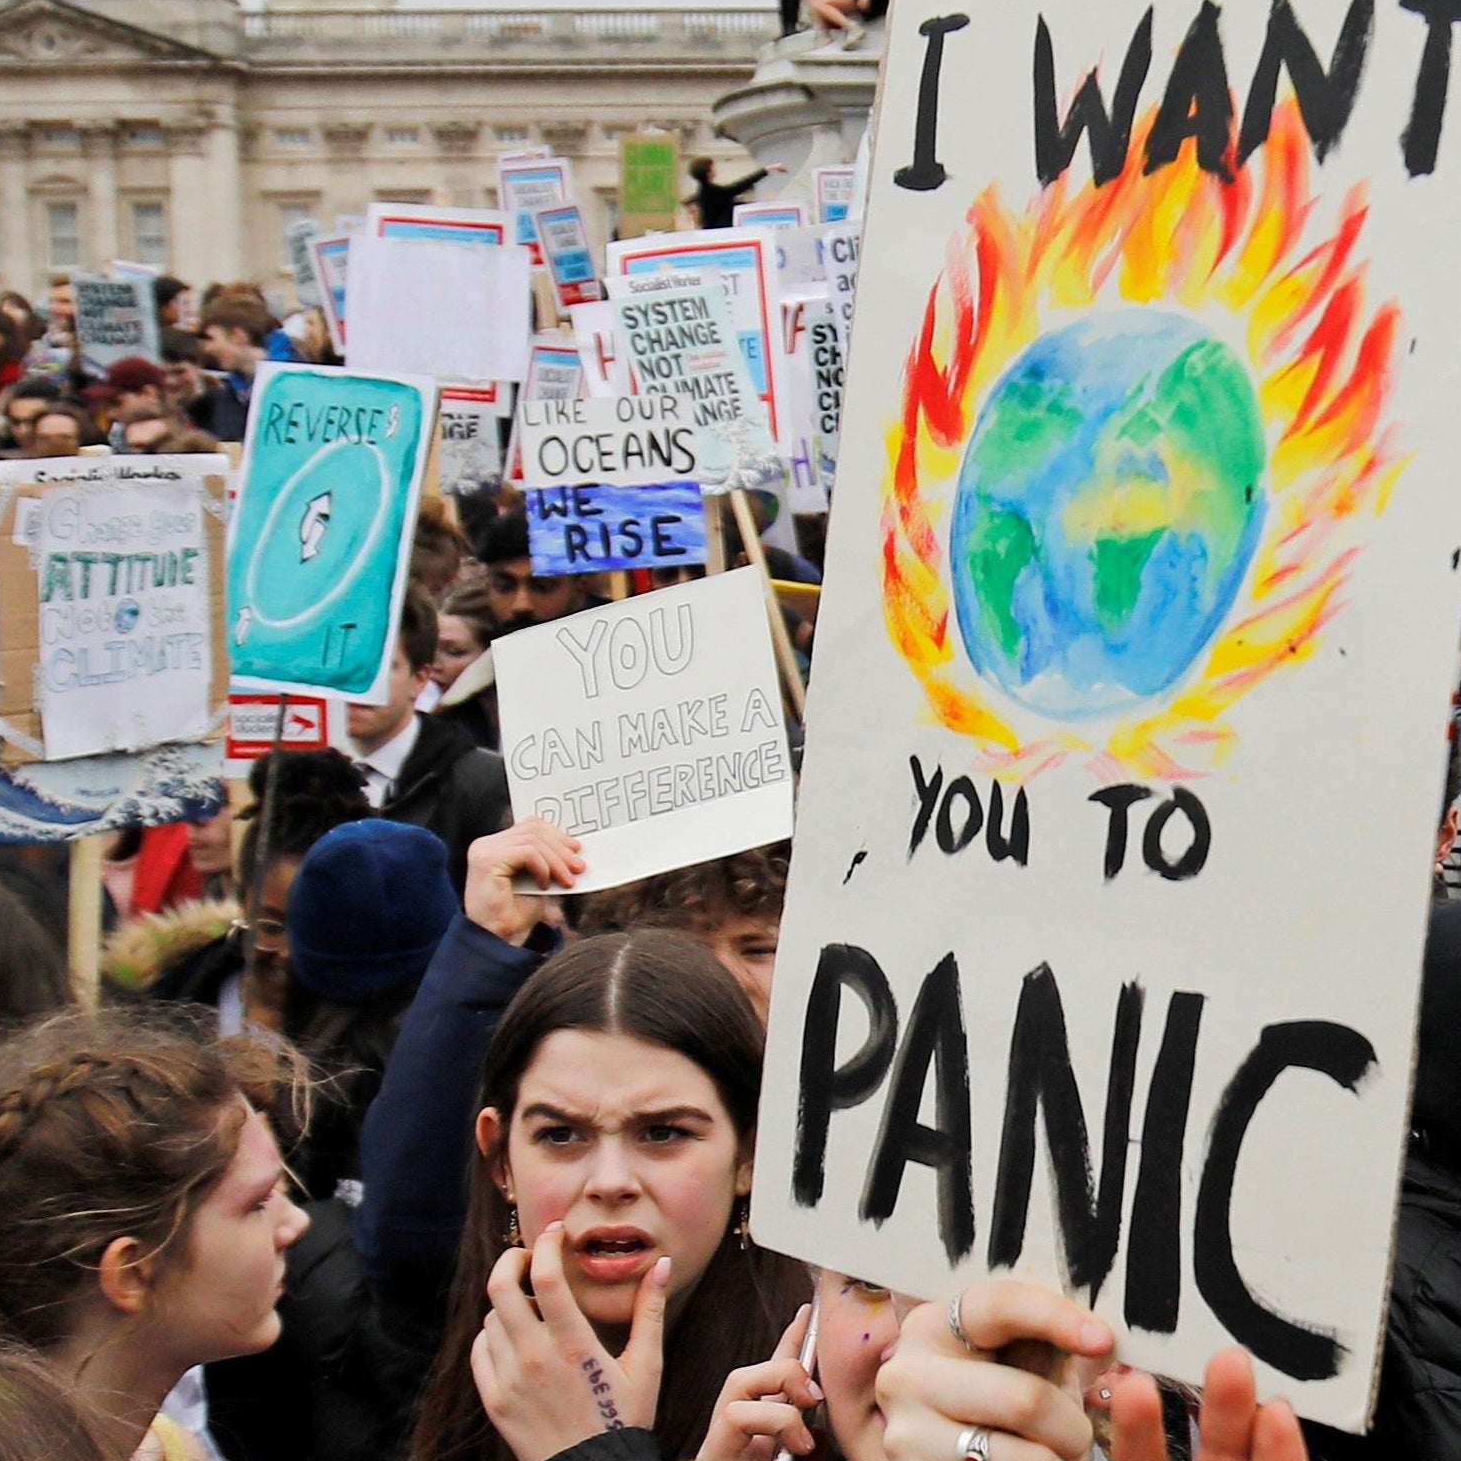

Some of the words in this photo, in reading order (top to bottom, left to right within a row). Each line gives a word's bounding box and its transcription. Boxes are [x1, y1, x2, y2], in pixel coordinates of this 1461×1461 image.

[892, 11, 971, 192] I
[628, 277, 672, 294] Socialist
[621, 296, 710, 330] SYSTEM
[630, 320, 722, 356] CHANGE
[637, 353, 684, 383] NOT
[264, 401, 387, 447] REVERSE
[524, 396, 587, 426] LIKE
[616, 394, 680, 423] OUR
[539, 427, 697, 478] OCEANS
[538, 482, 605, 521] WE
[565, 514, 688, 564] RISE
[323, 621, 357, 666] IT
[556, 602, 695, 699] YOU
[511, 720, 602, 781] CAN
[618, 693, 729, 758] MAKE
[741, 688, 778, 733] A
[533, 740, 786, 837] DIFFERENCE
[907, 754, 1030, 870] YOU
[1102, 782, 1212, 882] TO
[792, 943, 1382, 1380] PANIC
